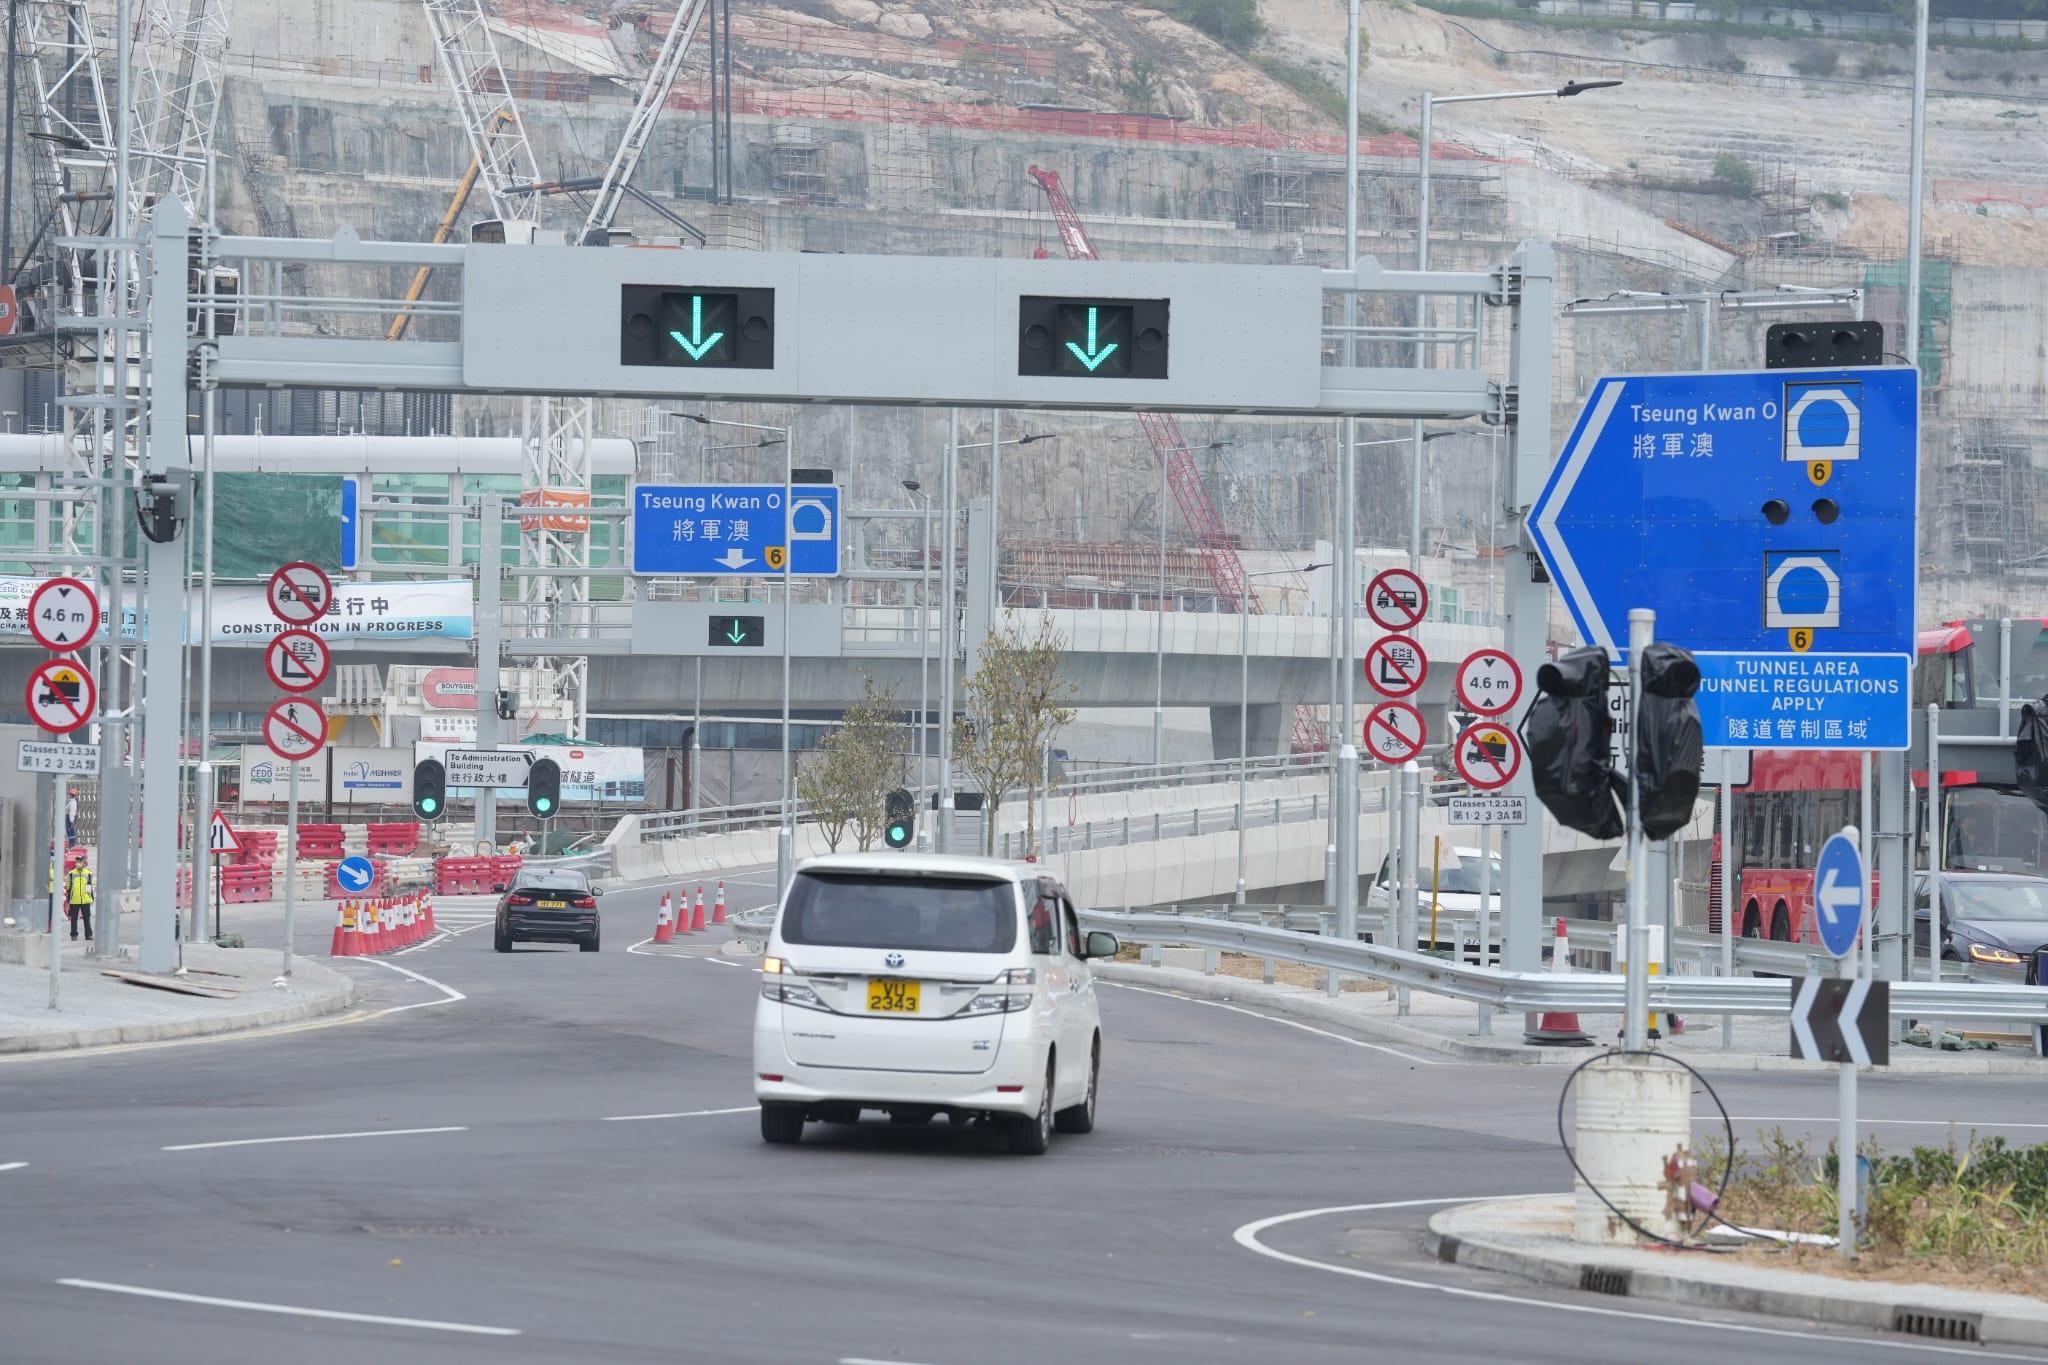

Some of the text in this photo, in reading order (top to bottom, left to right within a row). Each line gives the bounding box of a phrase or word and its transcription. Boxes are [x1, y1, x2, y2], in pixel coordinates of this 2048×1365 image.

[1630, 401, 1778, 426] Tseung Kwan O
[1632, 432, 1713, 459] 將軍澳
[1813, 463, 1825, 480] 6
[641, 493, 781, 512] Tseung Kwan O
[673, 518, 750, 542] 將軍澳
[770, 549, 782, 564] 6
[42, 609, 85, 623] 4.6 m
[221, 621, 444, 634] CONSTRUTION IN PROGRESS
[1795, 631, 1807, 648] 6
[1736, 661, 1860, 676] TUNNEL AREA
[441, 682, 474, 690] BOUYGUES
[1470, 677, 1509, 689] 4.6 m
[1700, 678, 1899, 694] TUNNEL REGULATIONS
[1771, 697, 1825, 711] APPLY
[1728, 718, 1868, 740] 隧道管制區域
[22, 744, 58, 755] Classes
[450, 753, 521, 763] To Administration
[250, 769, 273, 778] CEDD
[450, 762, 484, 771] Building
[450, 772, 508, 784] 往行政大樓
[1452, 800, 1487, 808] Classes
[883, 983, 906, 997] VU
[871, 996, 916, 1011] 2343
